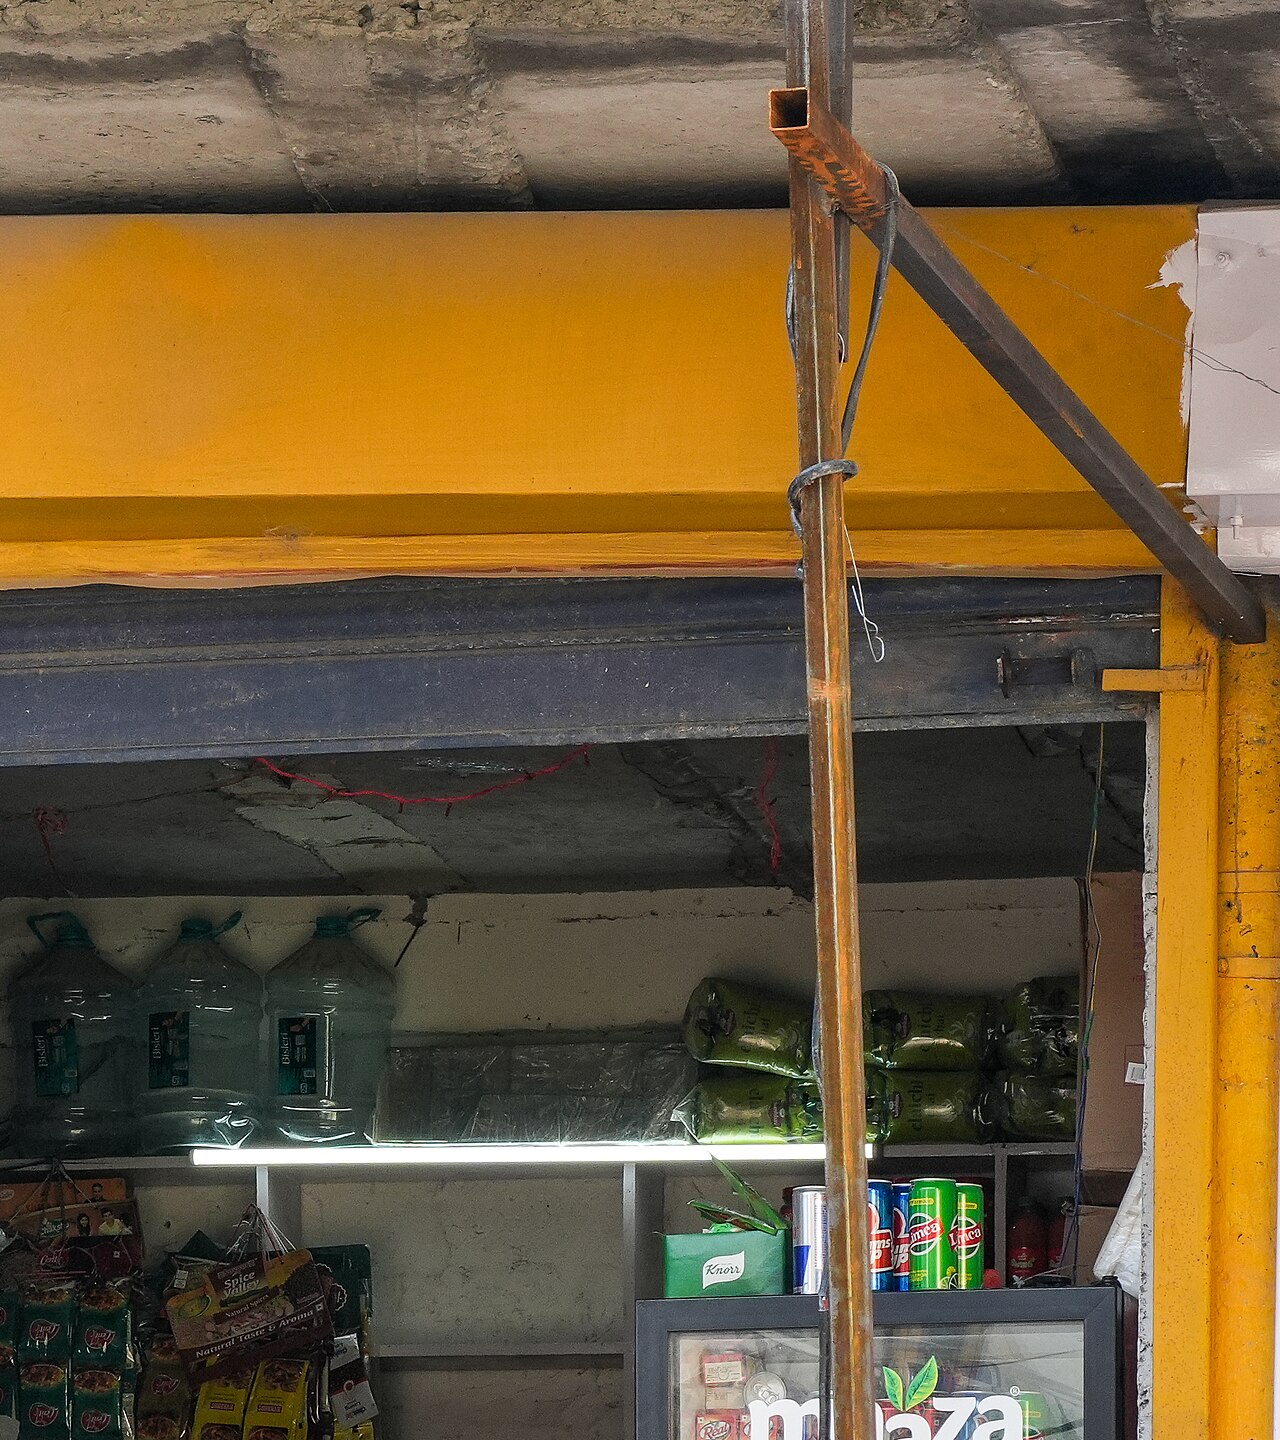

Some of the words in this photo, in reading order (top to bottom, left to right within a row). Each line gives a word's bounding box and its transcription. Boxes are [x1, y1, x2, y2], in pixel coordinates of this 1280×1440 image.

[151, 1026, 162, 1059] Bisleri
[278, 1031, 290, 1065] Bisleri
[705, 1261, 741, 1276] Knorr
[223, 1270, 256, 1290] Spice
[225, 1305, 248, 1318] Natural
[195, 1338, 236, 1359] Natural
[238, 1328, 266, 1344] Taste
[267, 1323, 277, 1333] &
[278, 1309, 315, 1327] Aroma
[699, 1420, 732, 1440] Real
